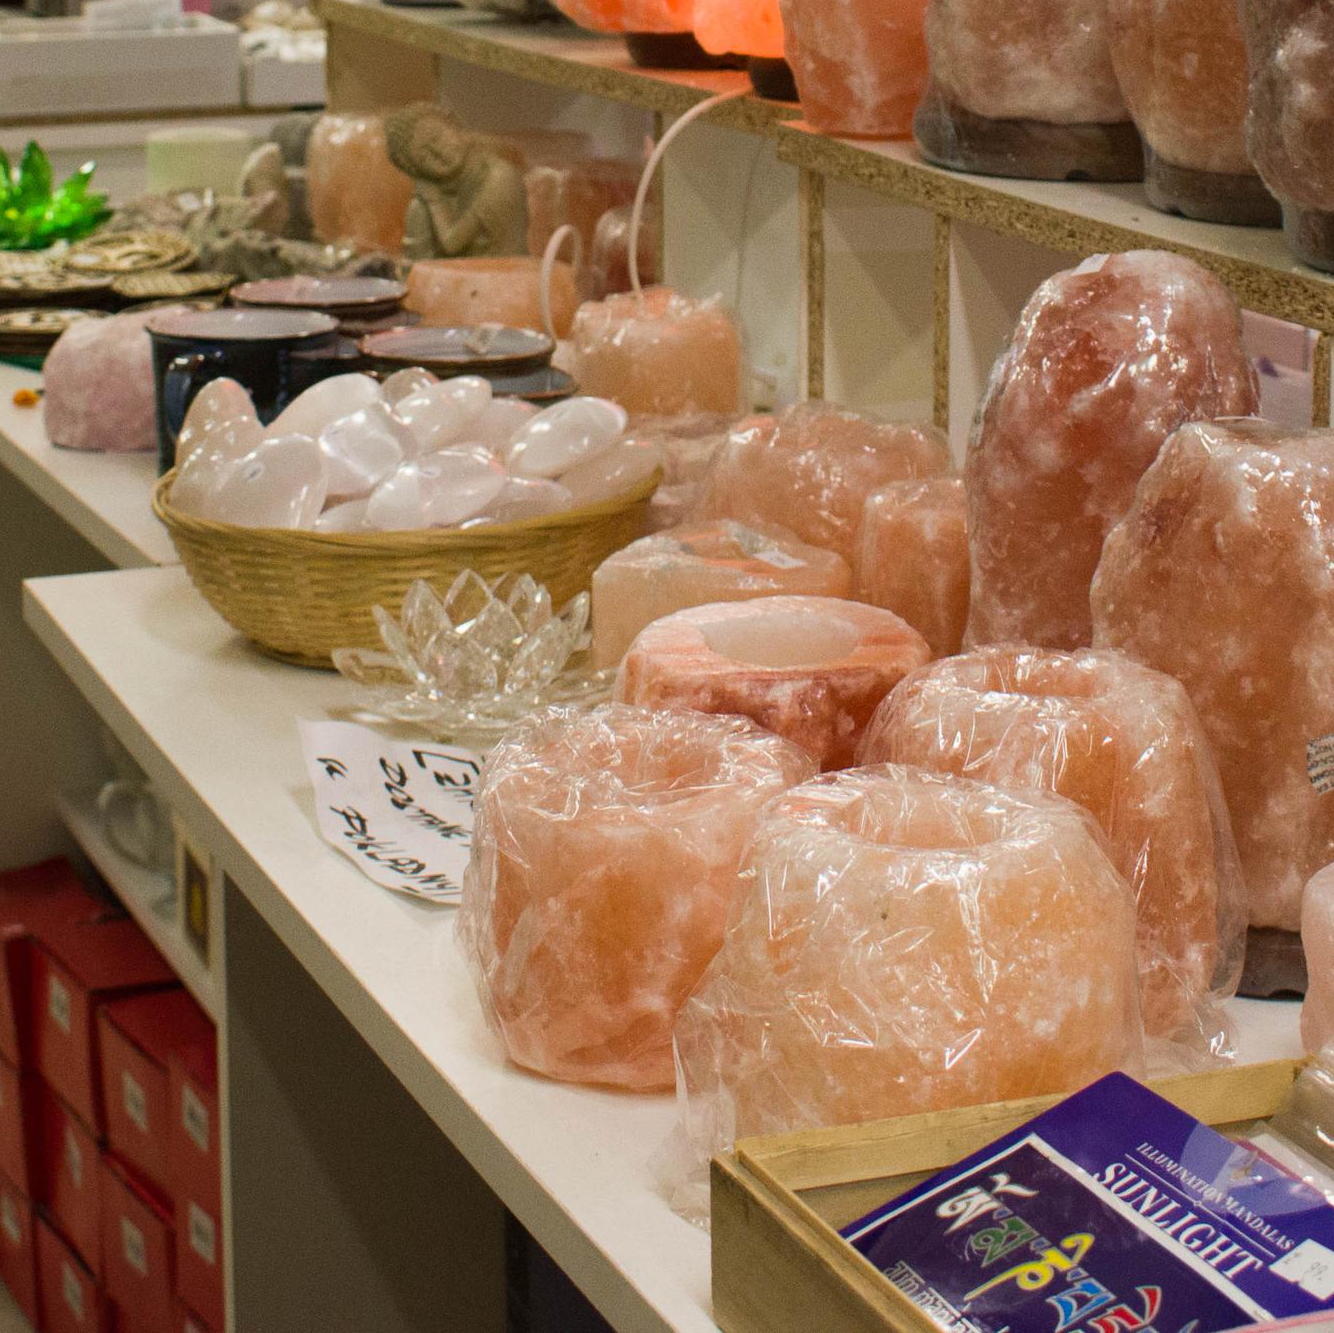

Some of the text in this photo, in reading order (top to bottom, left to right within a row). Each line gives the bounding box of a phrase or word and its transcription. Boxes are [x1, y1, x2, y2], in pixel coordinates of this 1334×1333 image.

[1093, 1161, 1265, 1280] SUNLIGHT
[1135, 1141, 1296, 1251] ILLUMINATION MANDALAS
